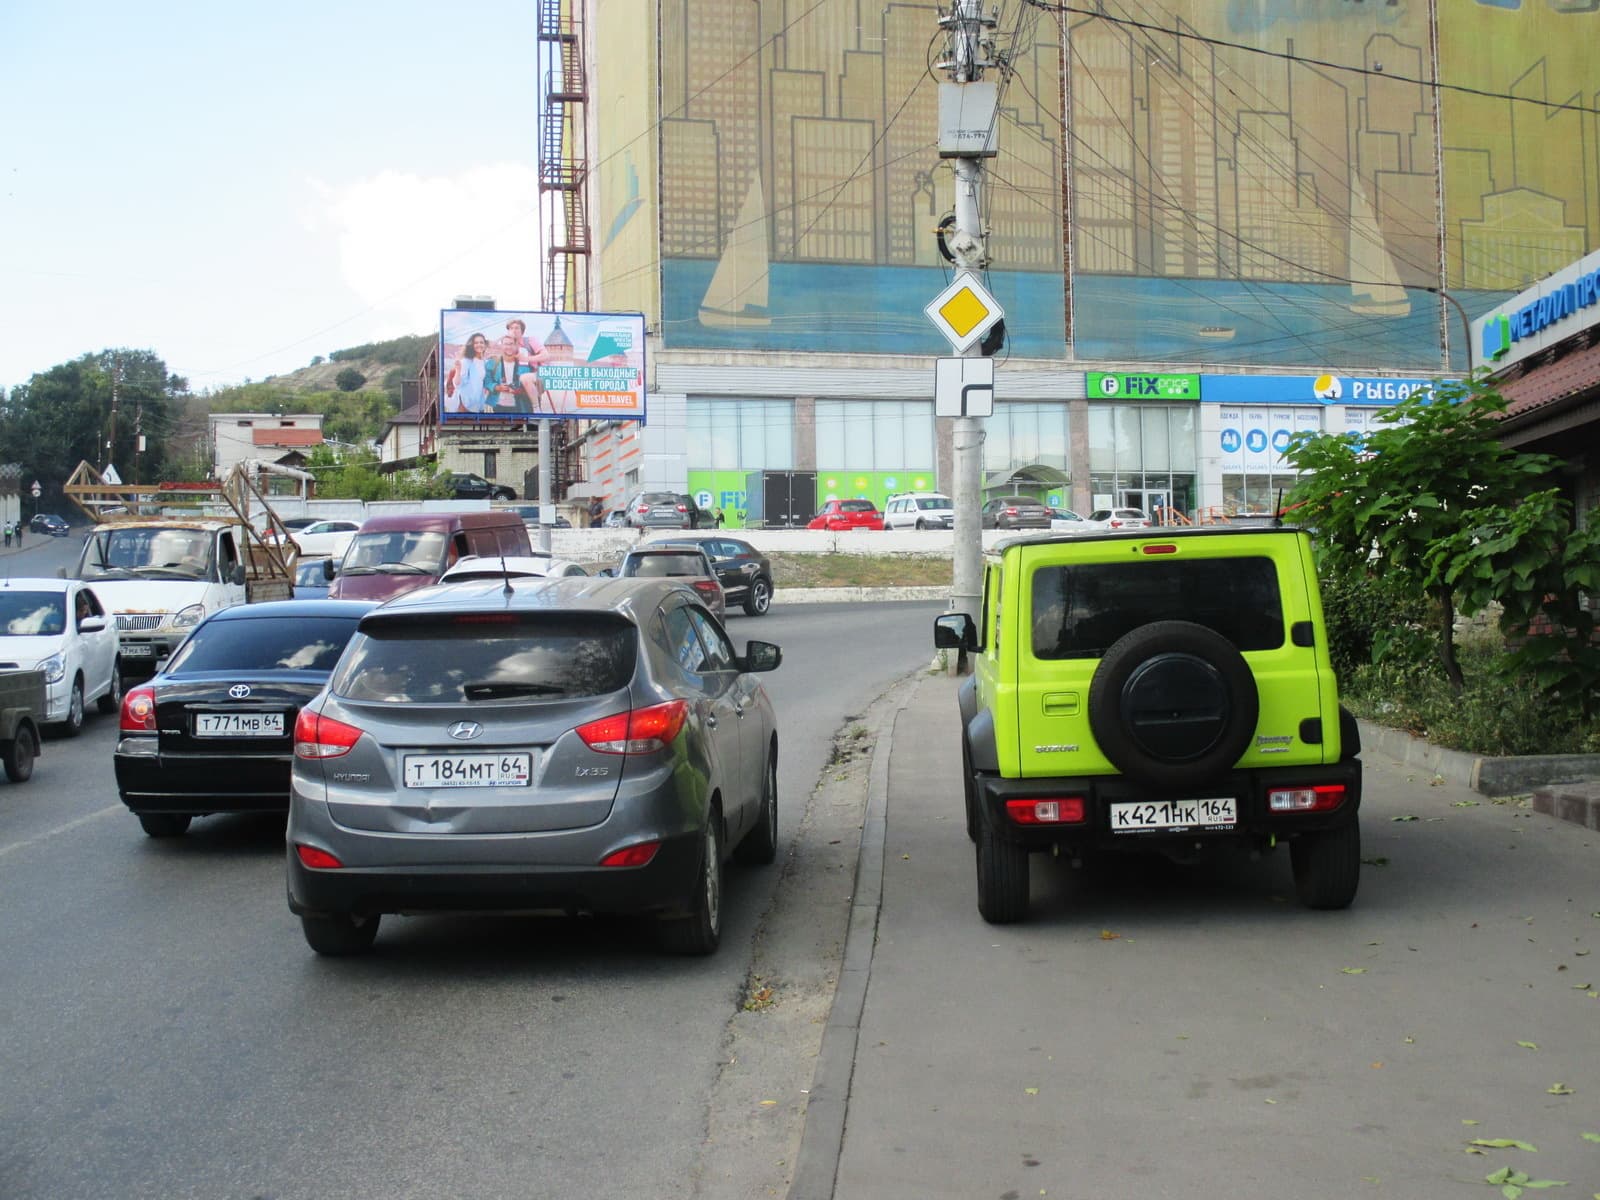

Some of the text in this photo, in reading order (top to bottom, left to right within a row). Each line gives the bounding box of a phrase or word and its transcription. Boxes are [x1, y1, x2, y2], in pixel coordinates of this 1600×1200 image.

[539, 367, 637, 379] ВЫХОДИТЕ В ВЫХОДНЫЕ
[545, 379, 626, 391] В СОСЕДНИЕ ГОРОДА
[580, 394, 633, 405] RUSSIA.TRAVEL
[203, 715, 279, 731] Т771МВ 64
[501, 757, 521, 773] 64
[1118, 801, 1231, 826] К421НК 164
